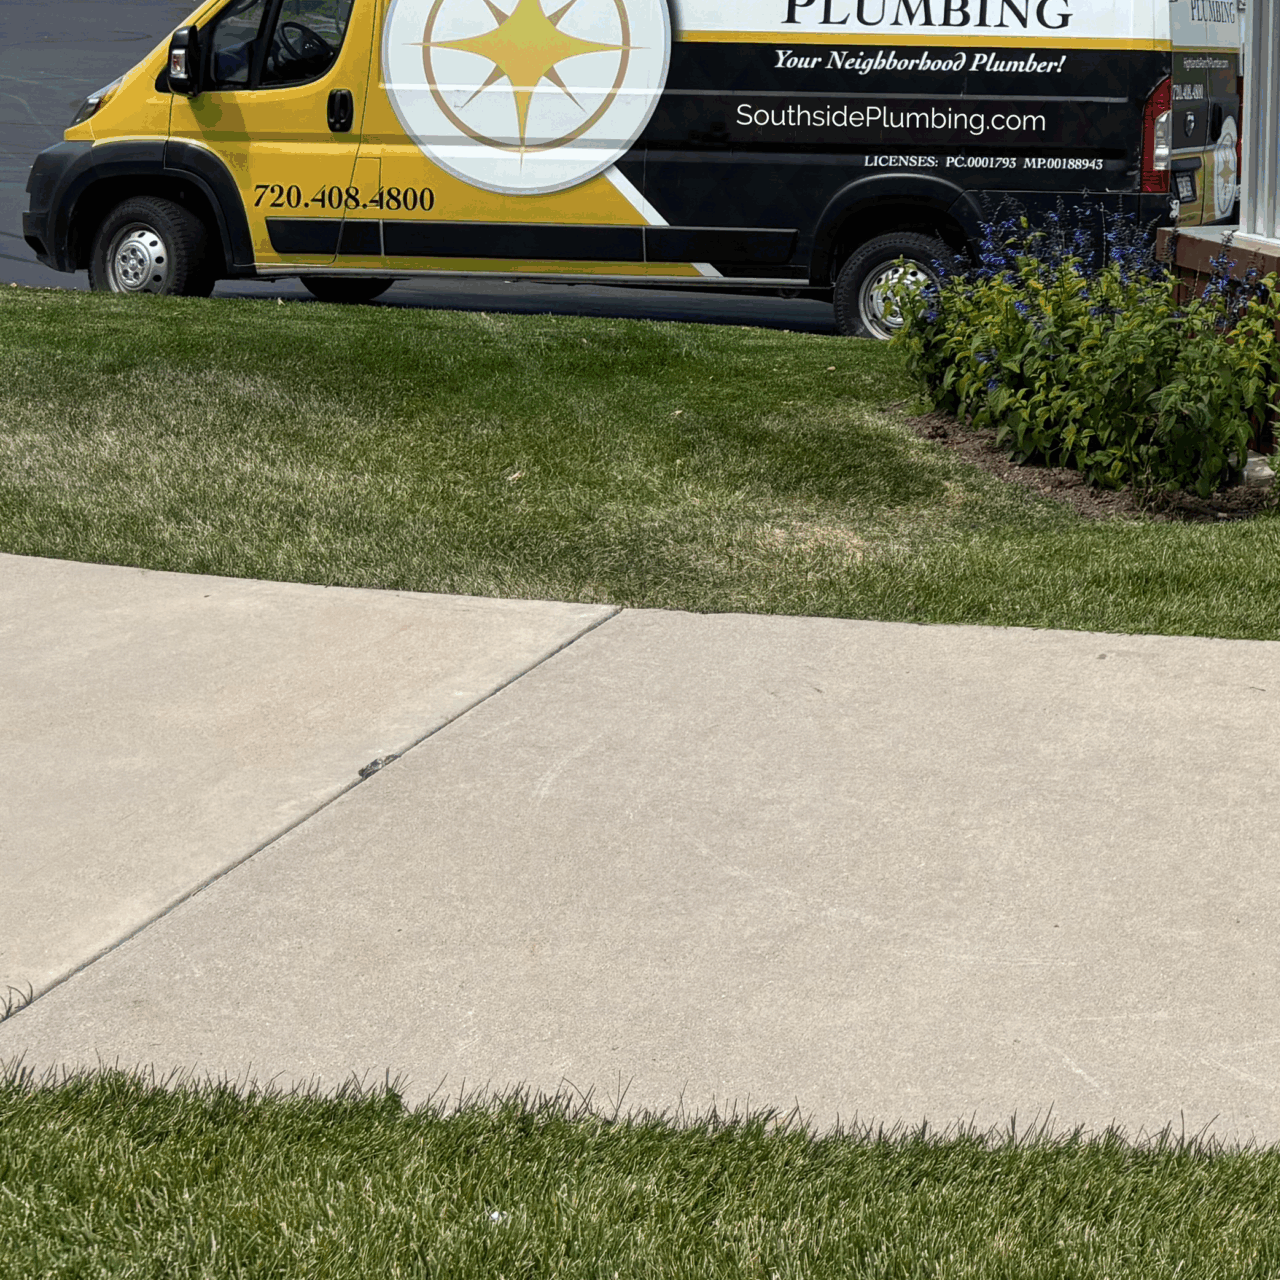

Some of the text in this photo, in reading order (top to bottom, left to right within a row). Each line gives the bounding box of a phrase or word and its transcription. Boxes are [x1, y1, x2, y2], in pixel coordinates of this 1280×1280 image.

[774, 49, 1067, 75] Your Neighborhood Plumber!
[736, 104, 1046, 135] SouthsidePlumbing.com
[864, 155, 1103, 170] LICENSES: PC.0001793 MP.00188943
[254, 184, 435, 211] 720.408.4800
